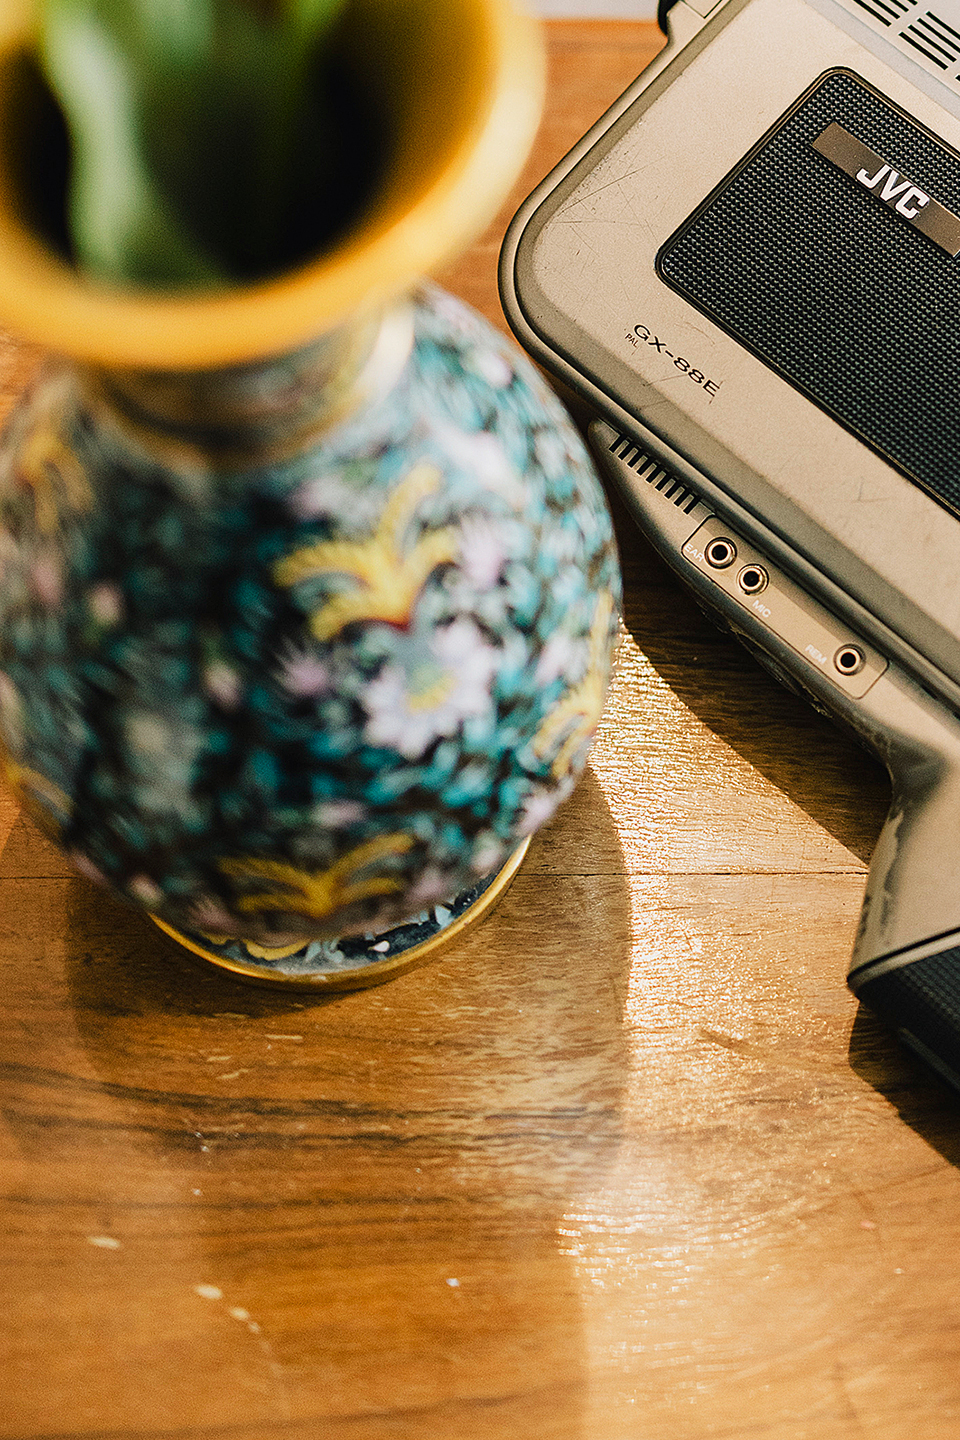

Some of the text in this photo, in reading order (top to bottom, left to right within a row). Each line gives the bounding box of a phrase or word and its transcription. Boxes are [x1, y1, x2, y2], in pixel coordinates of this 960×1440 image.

[855, 164, 931, 220] JVC
[633, 324, 720, 397] GX-88E
[684, 543, 704, 562] EAR
[752, 600, 771, 618] MIC
[805, 644, 827, 664] REM
